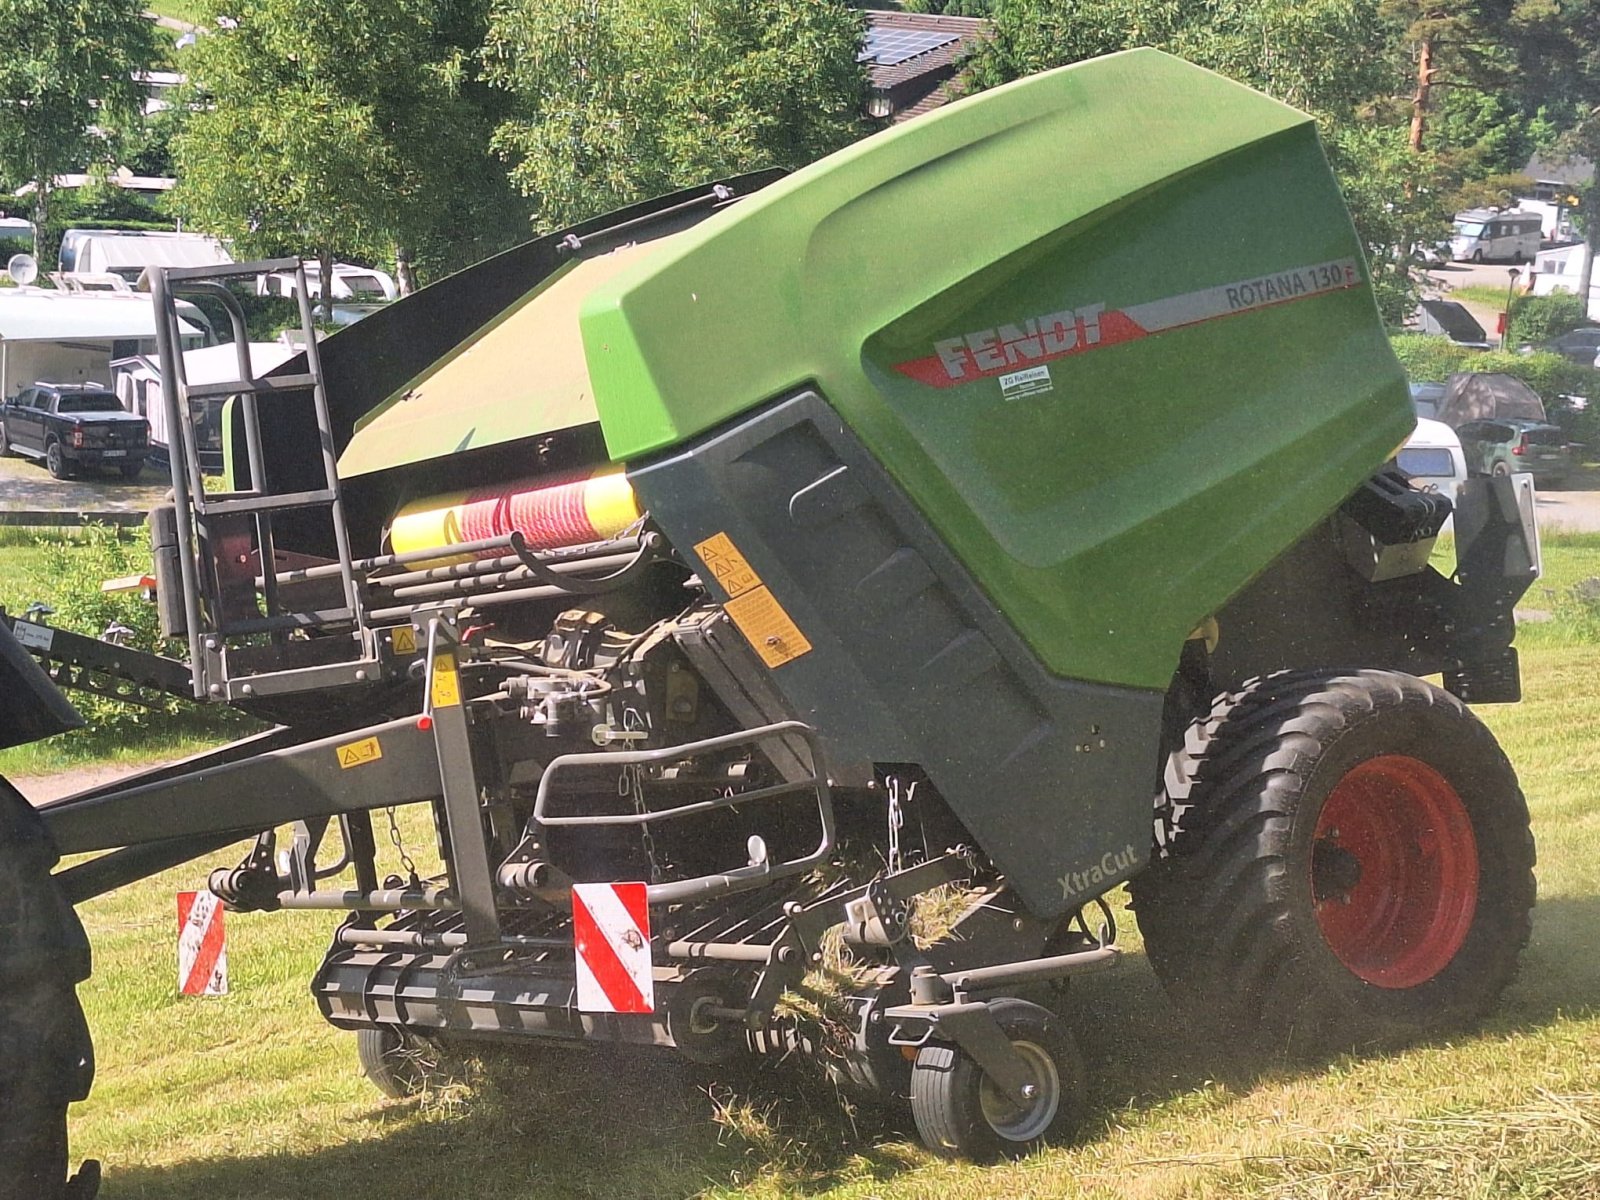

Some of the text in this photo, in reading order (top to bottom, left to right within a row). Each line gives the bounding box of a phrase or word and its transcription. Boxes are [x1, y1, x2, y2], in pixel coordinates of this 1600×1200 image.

[1226, 273, 1305, 309] ROTANA
[1309, 264, 1340, 289] 130
[933, 302, 1106, 379] FENDT
[1057, 844, 1138, 900] XtraCut
